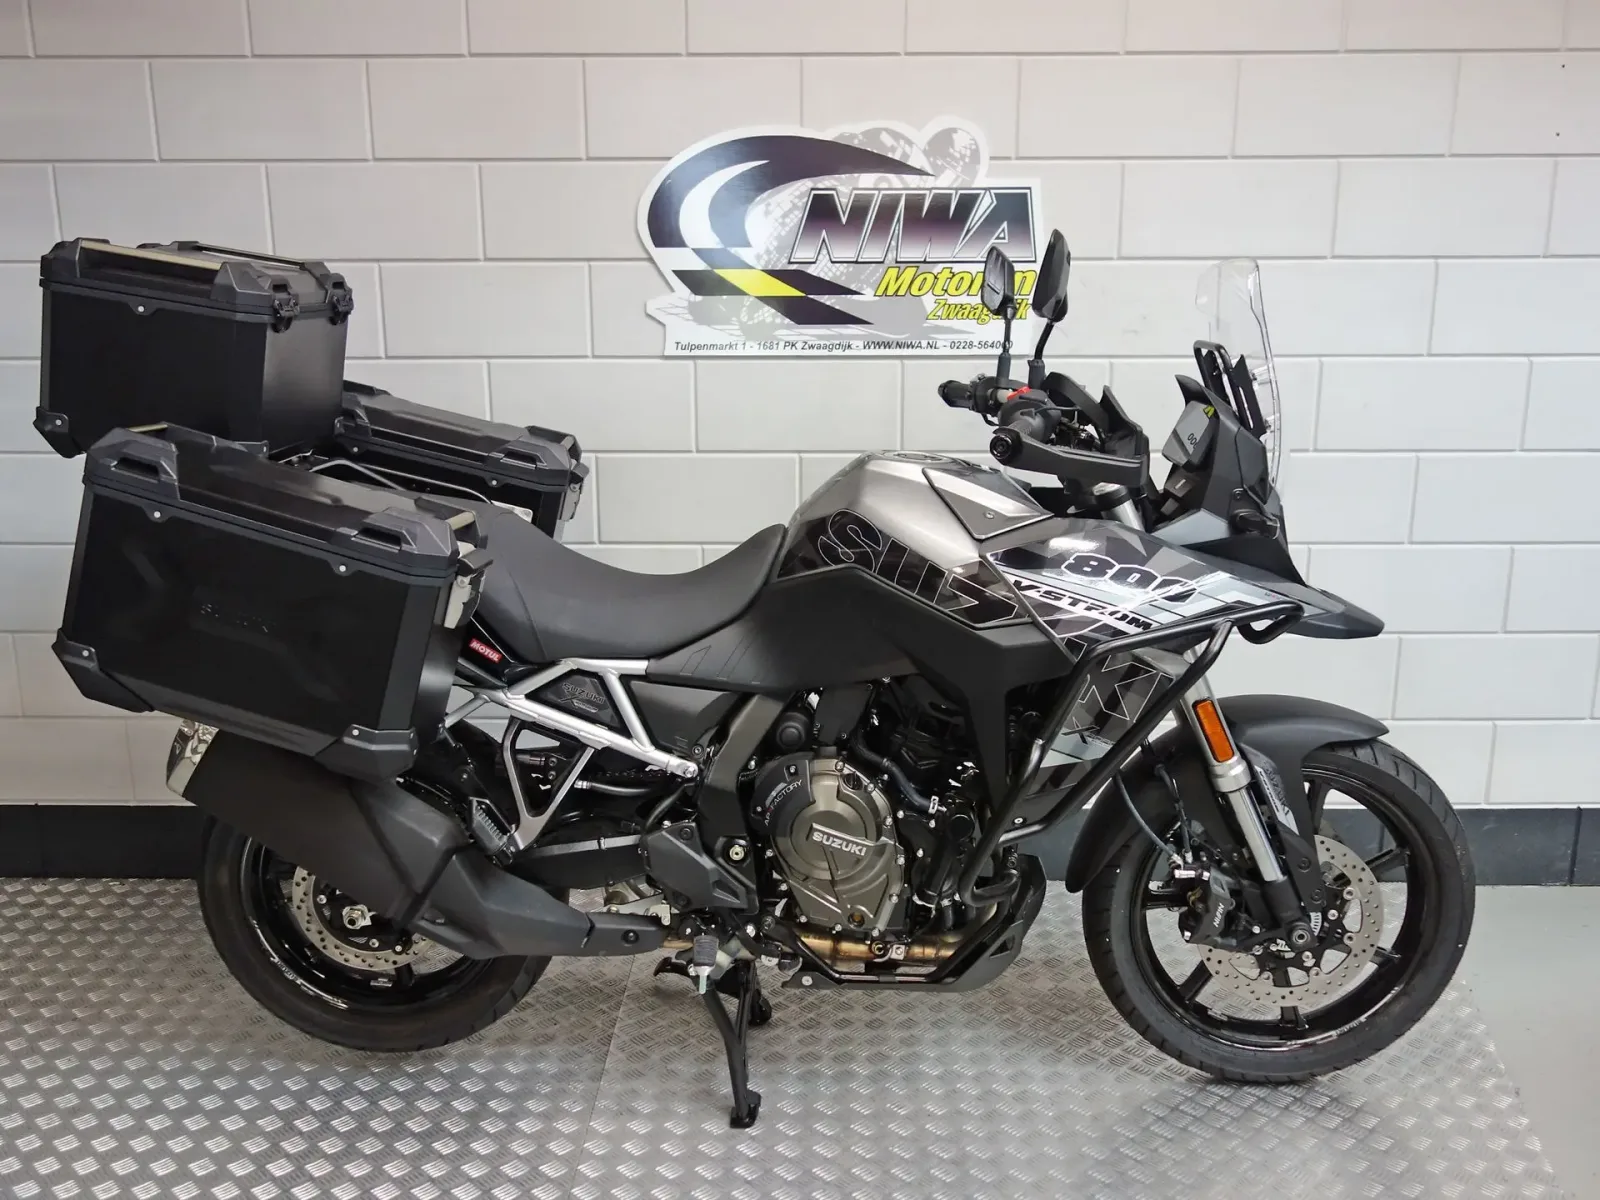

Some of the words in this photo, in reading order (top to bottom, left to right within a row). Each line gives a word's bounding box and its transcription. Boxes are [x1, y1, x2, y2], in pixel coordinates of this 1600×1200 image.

[789, 187, 1037, 264] NIWA
[874, 265, 1037, 297] Motorn
[926, 299, 1031, 325] Zwaagk
[674, 341, 739, 353] Tulpenmarkt
[741, 341, 747, 350] 1
[757, 341, 780, 350] 1681
[783, 341, 799, 350] PK
[801, 341, 853, 353] Zwaagdijk
[863, 340, 940, 350] WWW.NIWA.NL
[469, 640, 500, 663] MOTUL
[562, 682, 606, 705] SUZUKI
[812, 831, 867, 856] SUZUKI
